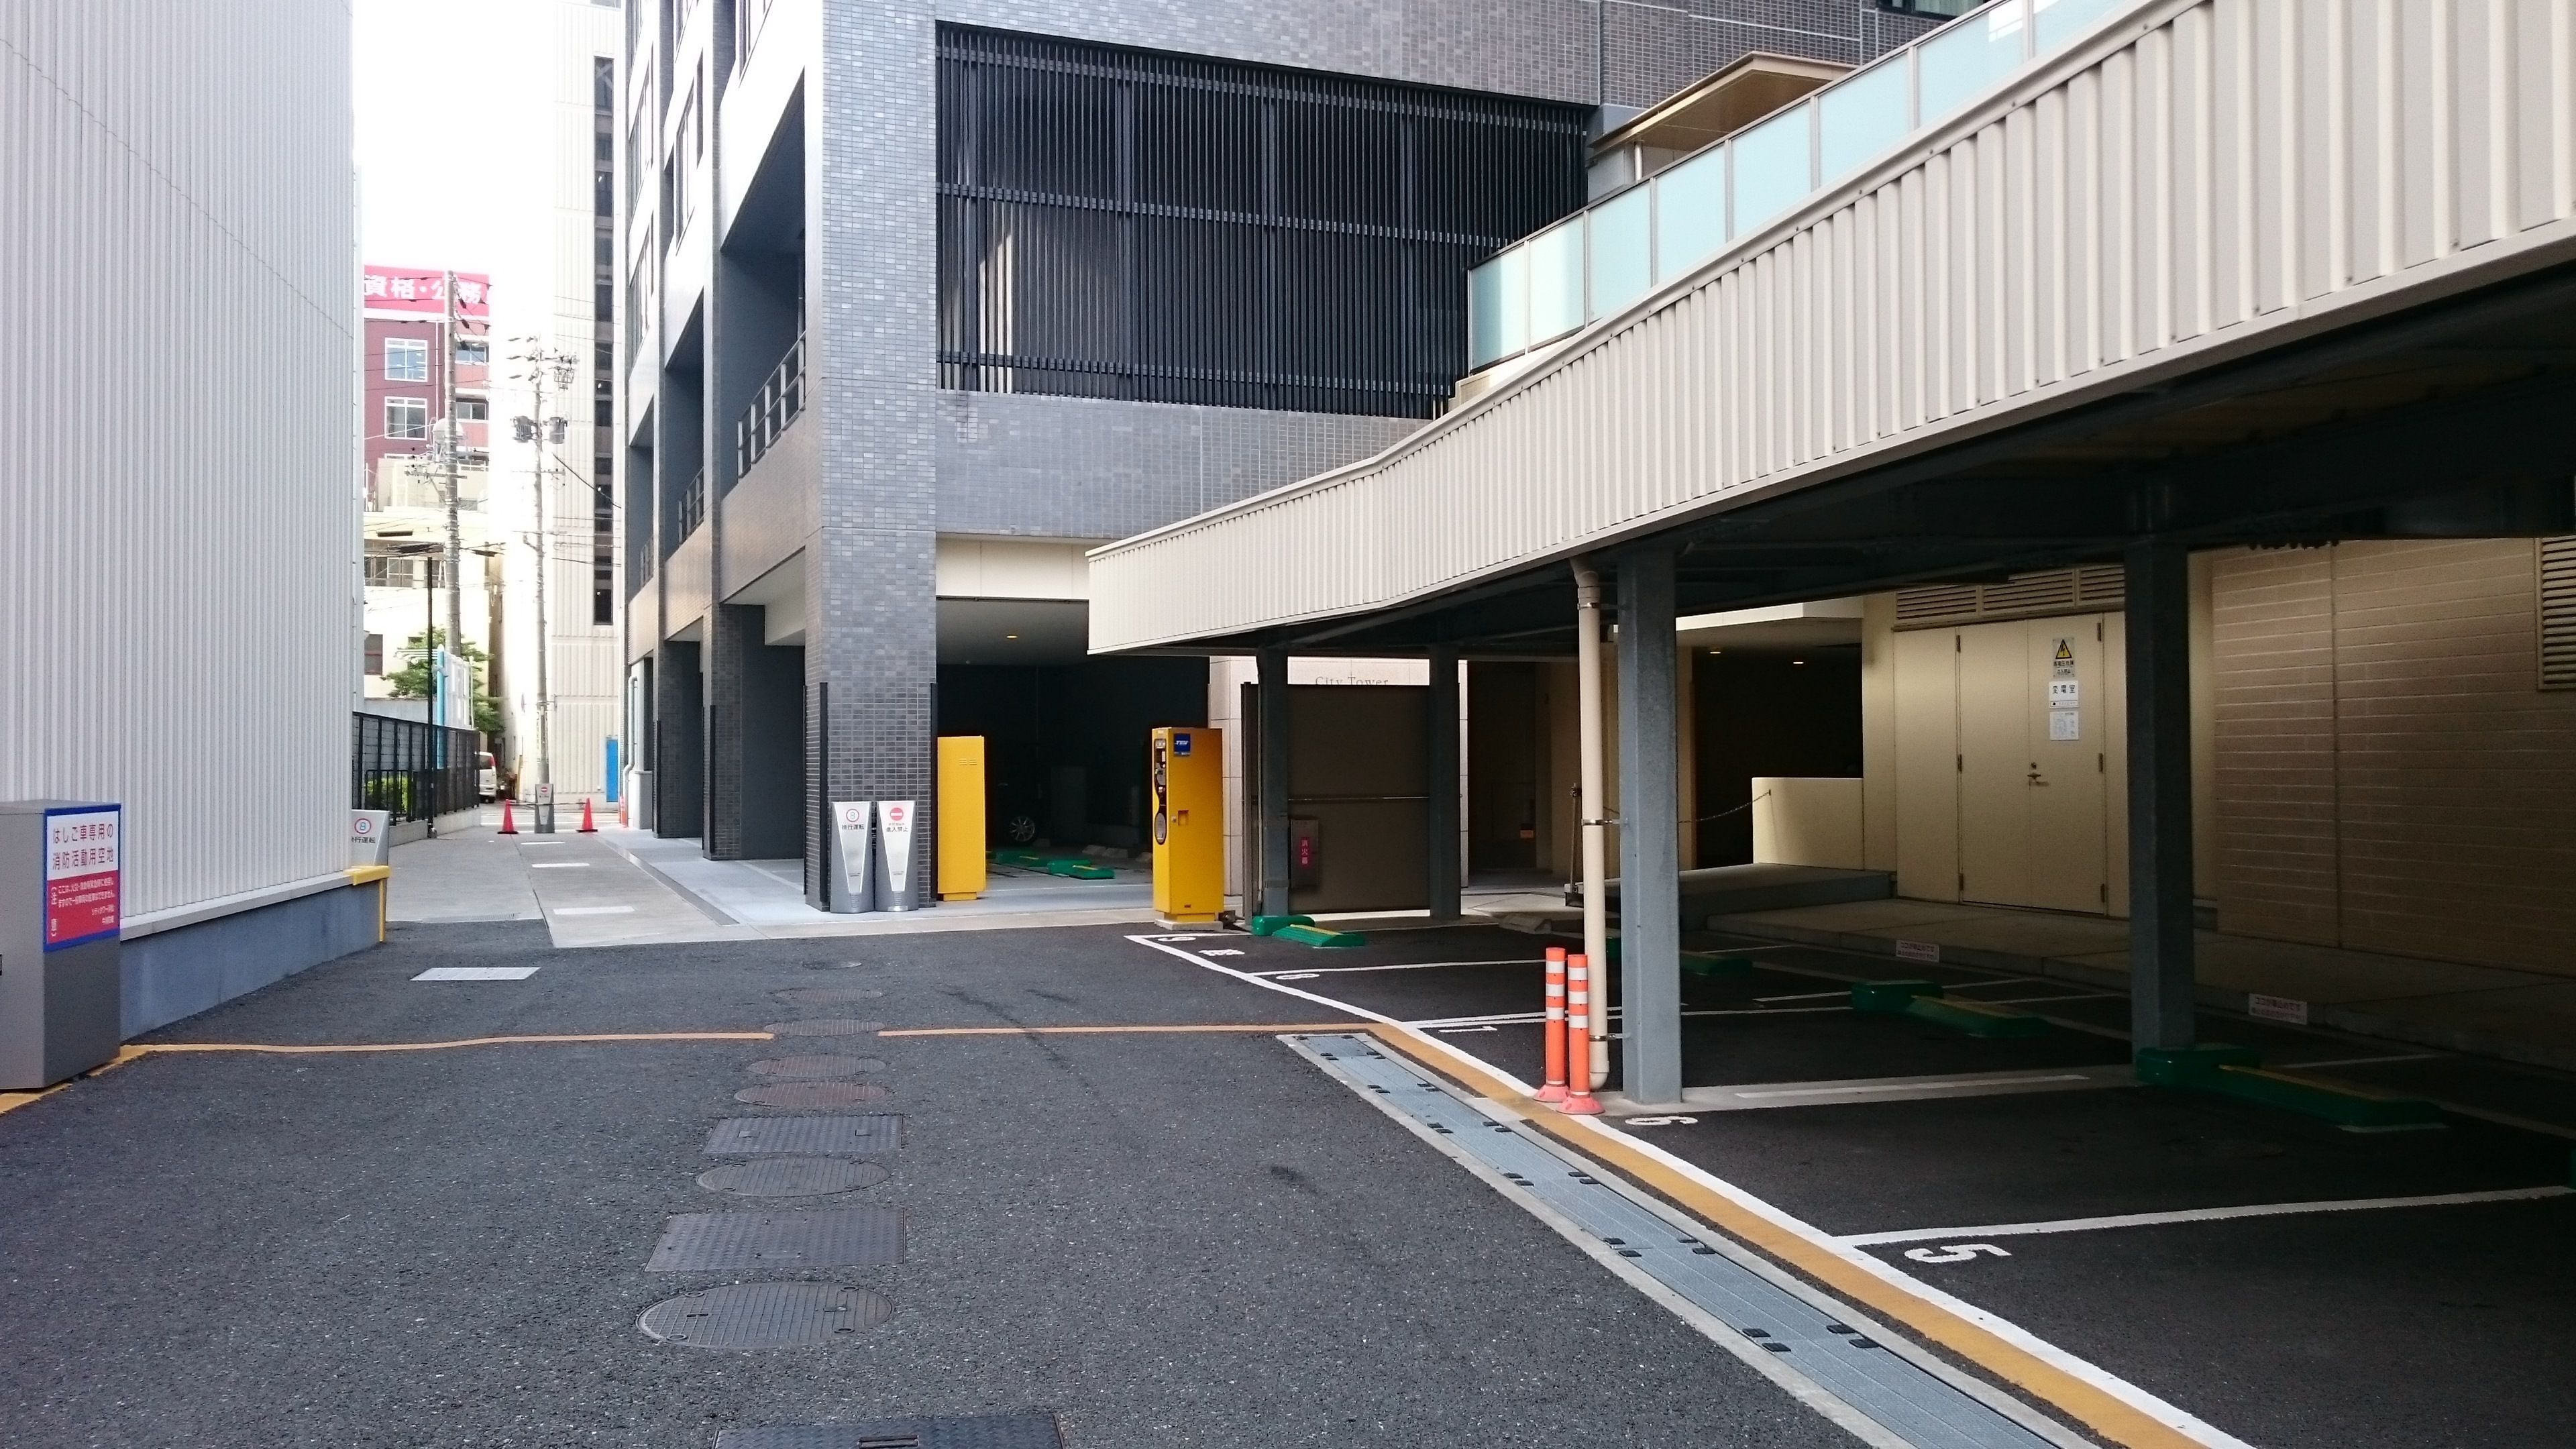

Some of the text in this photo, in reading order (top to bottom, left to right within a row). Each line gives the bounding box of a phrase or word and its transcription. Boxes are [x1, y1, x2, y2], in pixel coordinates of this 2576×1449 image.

[364, 274, 489, 305] 資格・公務
[1348, 676, 1388, 685] Tower
[53, 823, 113, 844] はしご車専用の
[53, 846, 113, 870] 消防活動用空地
[1625, 1116, 1698, 1126] 6
[1904, 1244, 2012, 1263] 5
